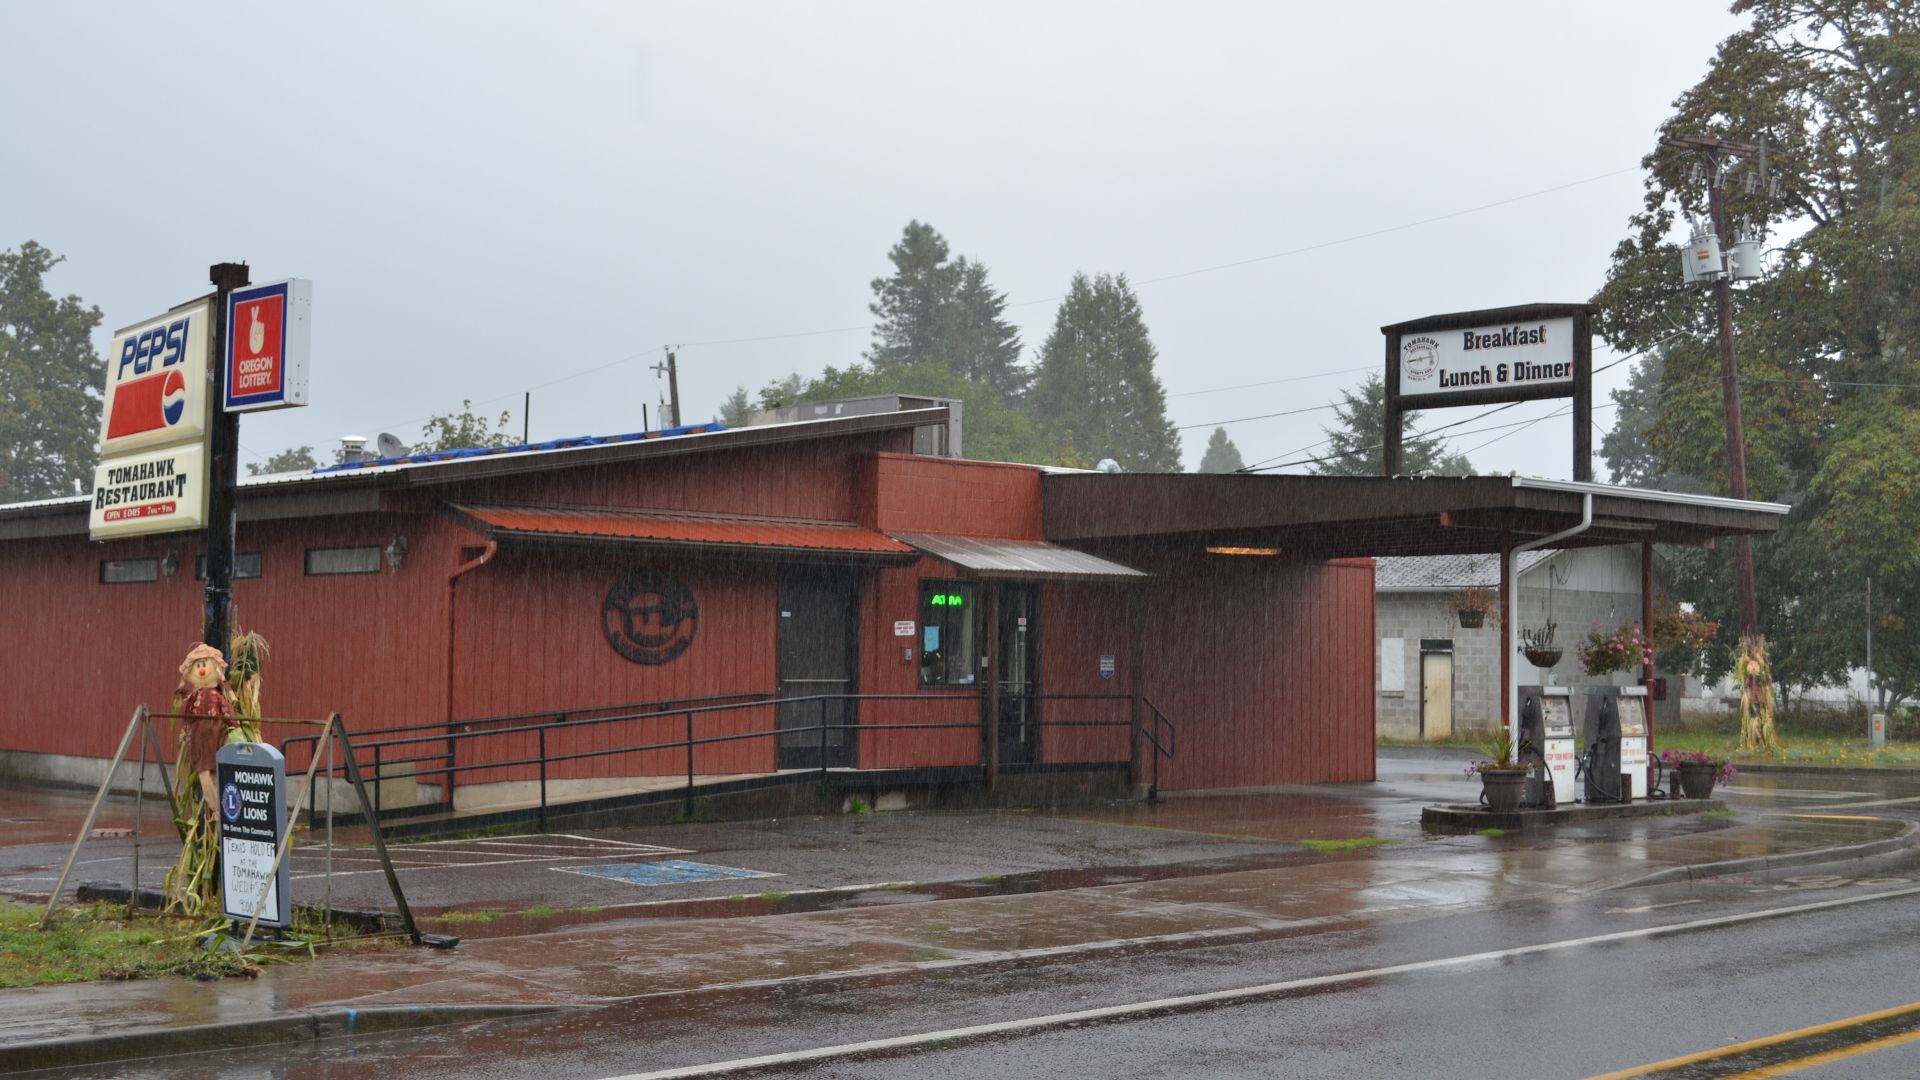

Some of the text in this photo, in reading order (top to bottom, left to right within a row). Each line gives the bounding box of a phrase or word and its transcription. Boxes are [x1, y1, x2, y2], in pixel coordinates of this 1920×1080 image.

[1403, 336, 1440, 351] TOMAHAWK
[1463, 324, 1547, 350] Breakfast
[117, 317, 190, 380] PEPSI
[239, 356, 273, 374] OREGON
[239, 371, 271, 389] LOTTERY
[1439, 361, 1573, 388] Lunch & Dinner
[108, 458, 175, 485] TOMAHAWK
[95, 473, 187, 510] RESTAURANT
[931, 594, 962, 605] ATM
[234, 771, 274, 786] MOHAWK
[228, 795, 235, 809] L
[240, 789, 270, 804] VALLEY
[243, 807, 267, 821] LIONS
[223, 823, 274, 838] We Serve The Community
[250, 841, 265, 857] HOLD
